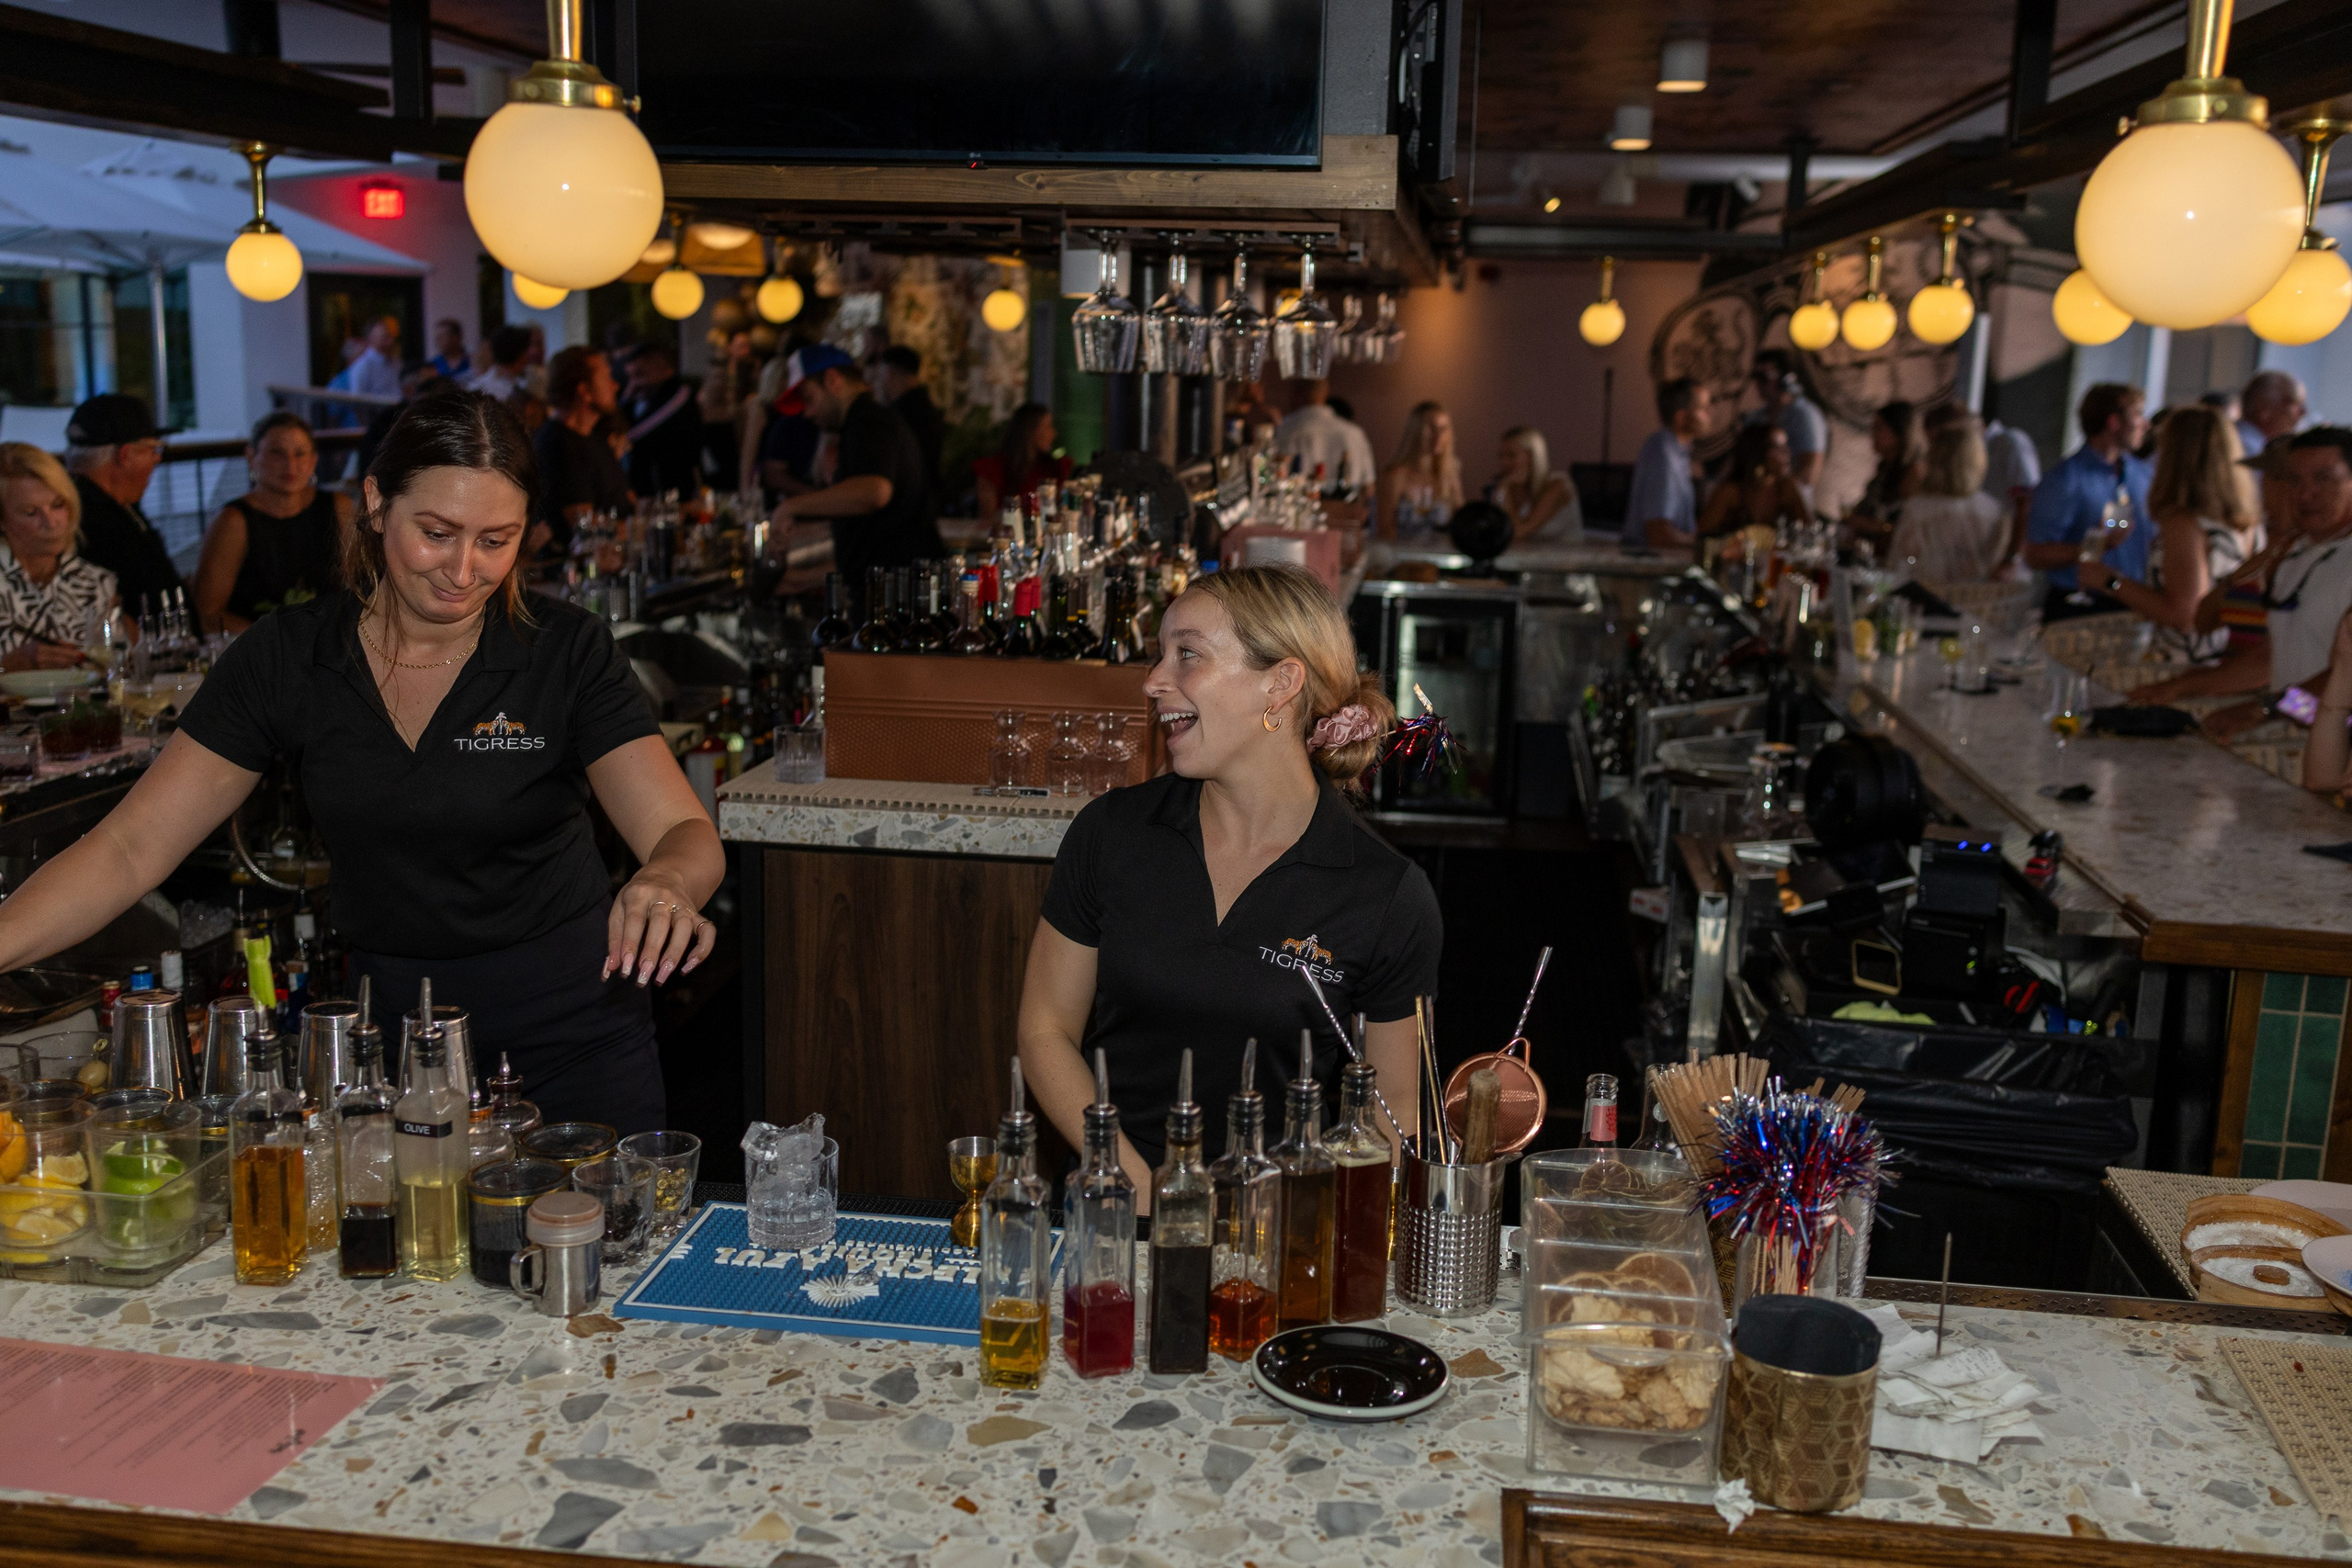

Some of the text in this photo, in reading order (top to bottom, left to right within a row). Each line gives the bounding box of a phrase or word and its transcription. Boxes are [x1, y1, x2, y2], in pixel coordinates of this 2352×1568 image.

[454, 737, 546, 750] TIGRESS
[1259, 946, 1344, 983] TIGRESS
[404, 1122, 430, 1134] OLIVE
[715, 1247, 982, 1284] LECHA AZUL
